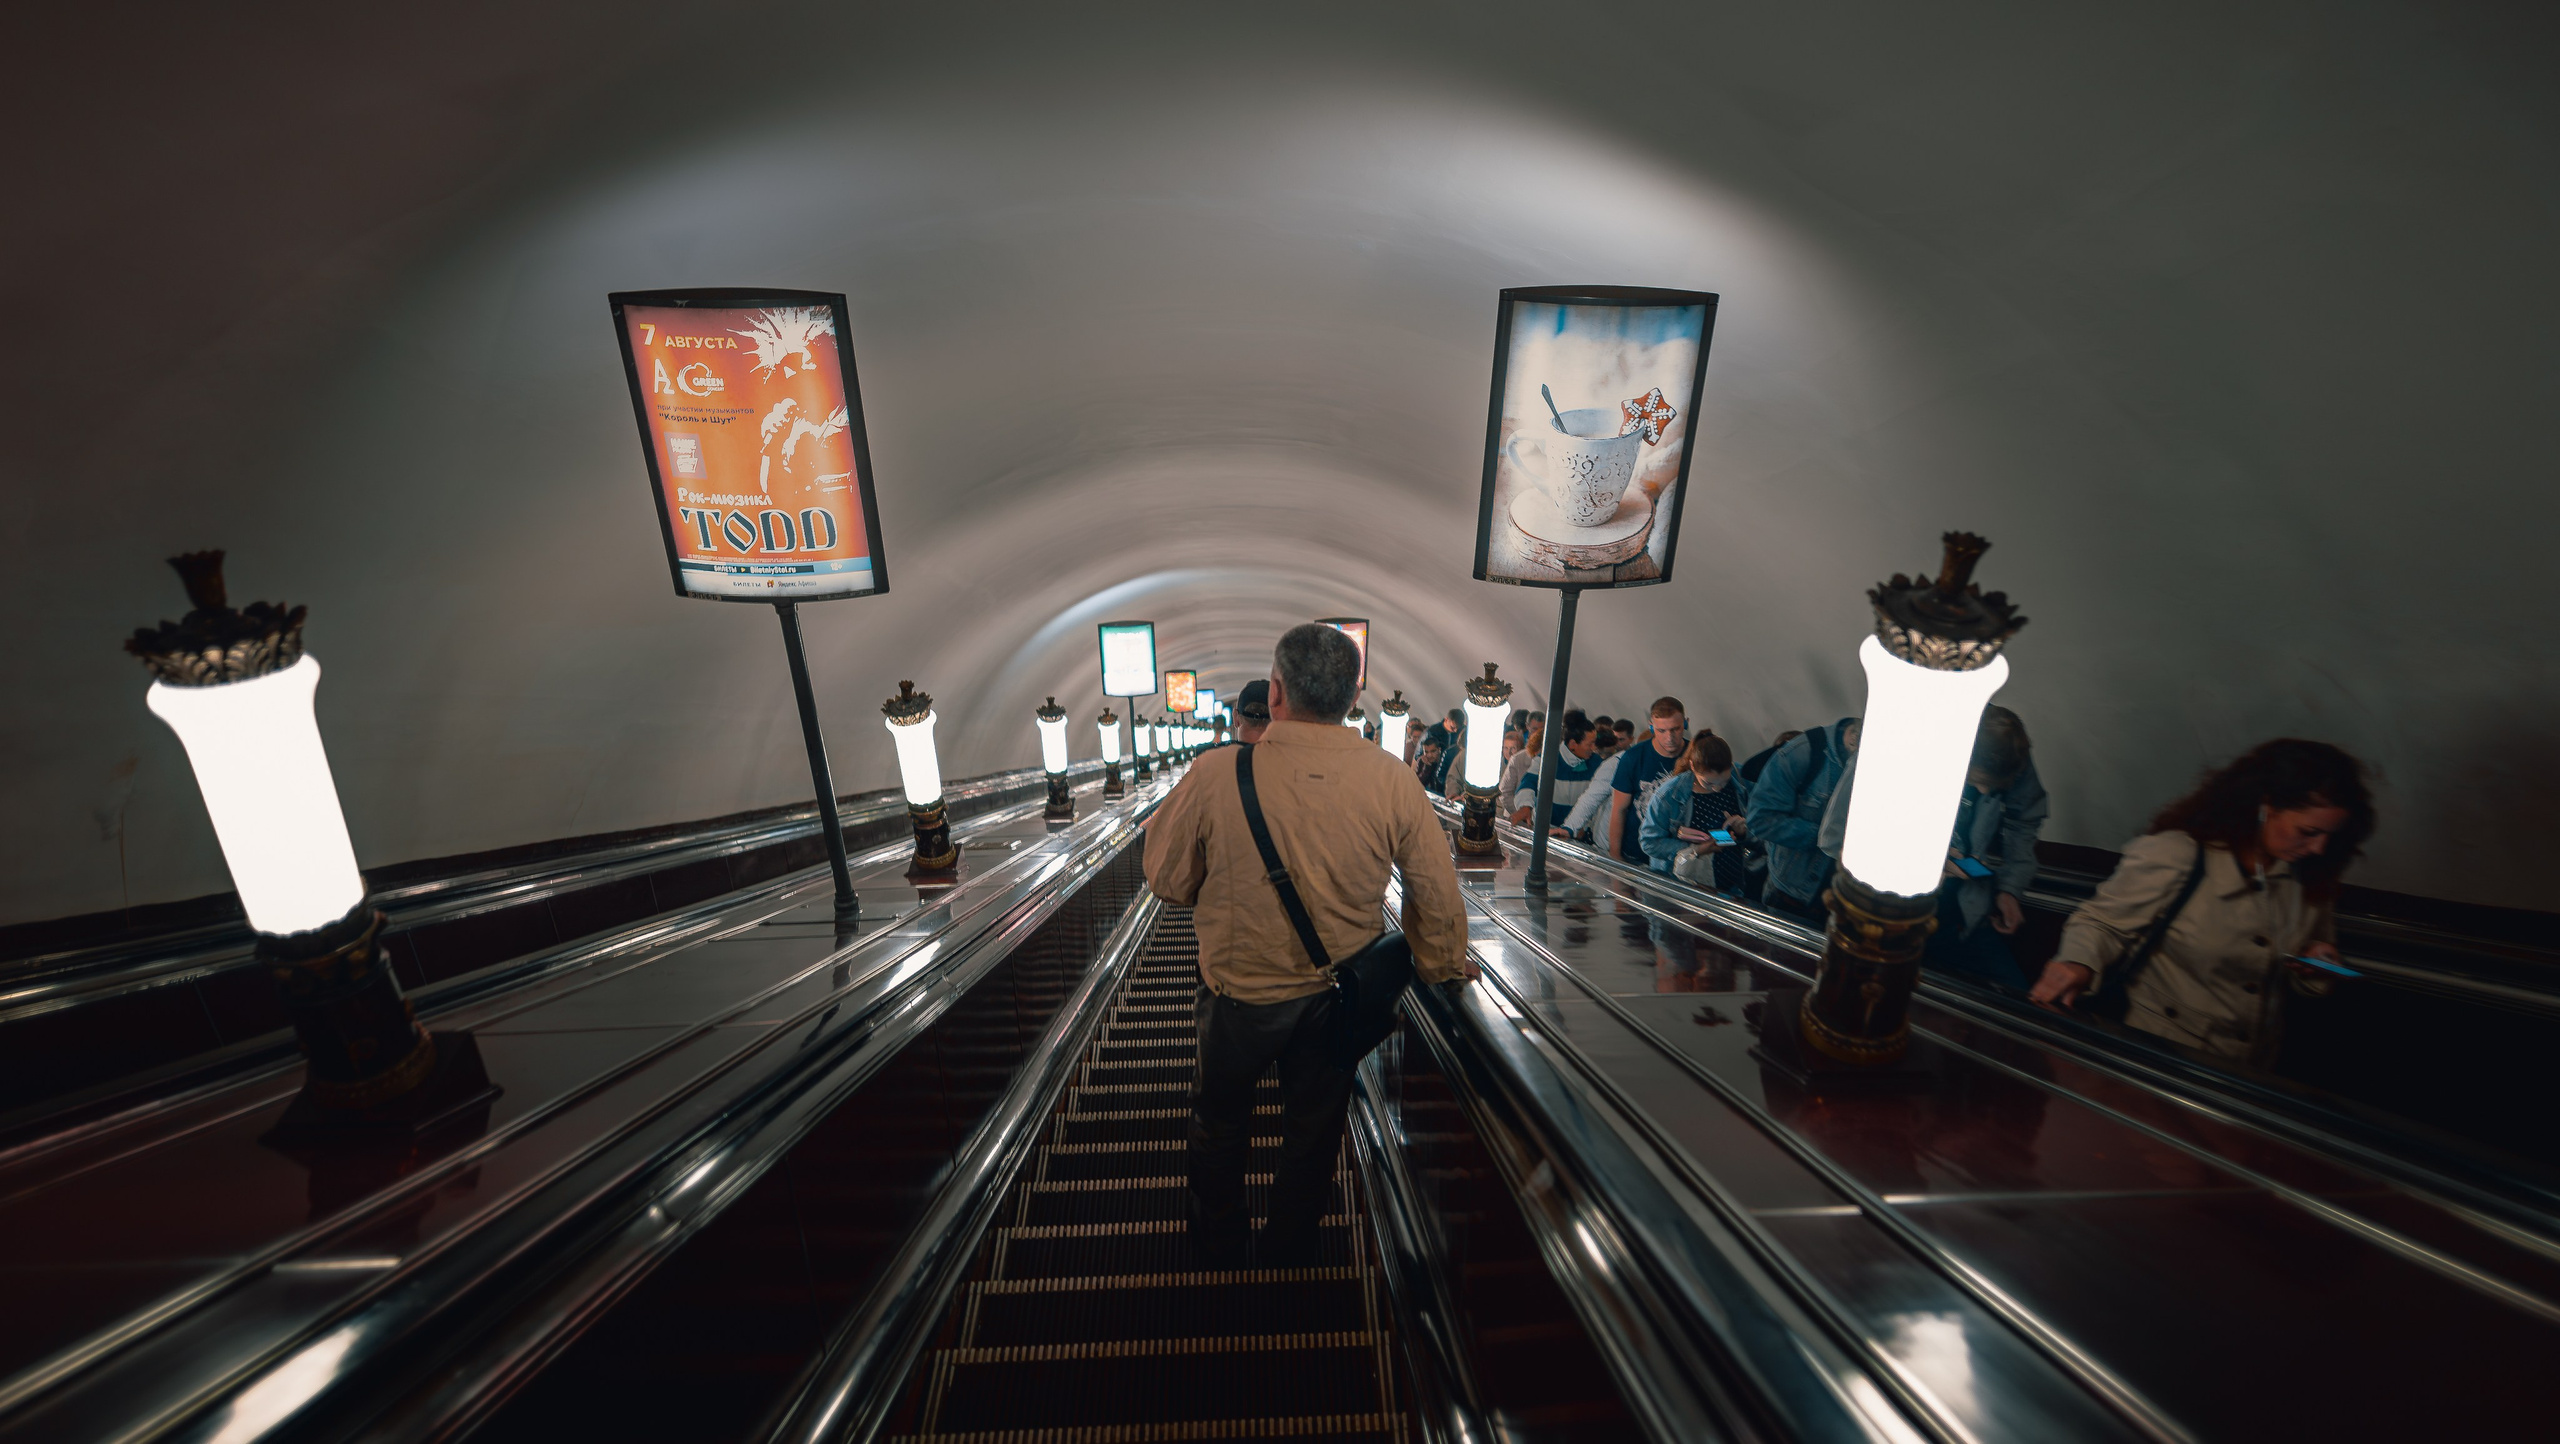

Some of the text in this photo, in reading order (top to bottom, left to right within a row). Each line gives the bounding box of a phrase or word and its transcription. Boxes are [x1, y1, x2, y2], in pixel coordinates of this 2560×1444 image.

[640, 324, 738, 349] 7 АВГУСТА
[692, 377, 724, 387] GREEN
[679, 506, 838, 554] TODD
[713, 565, 738, 573] БИЛЕТЫ
